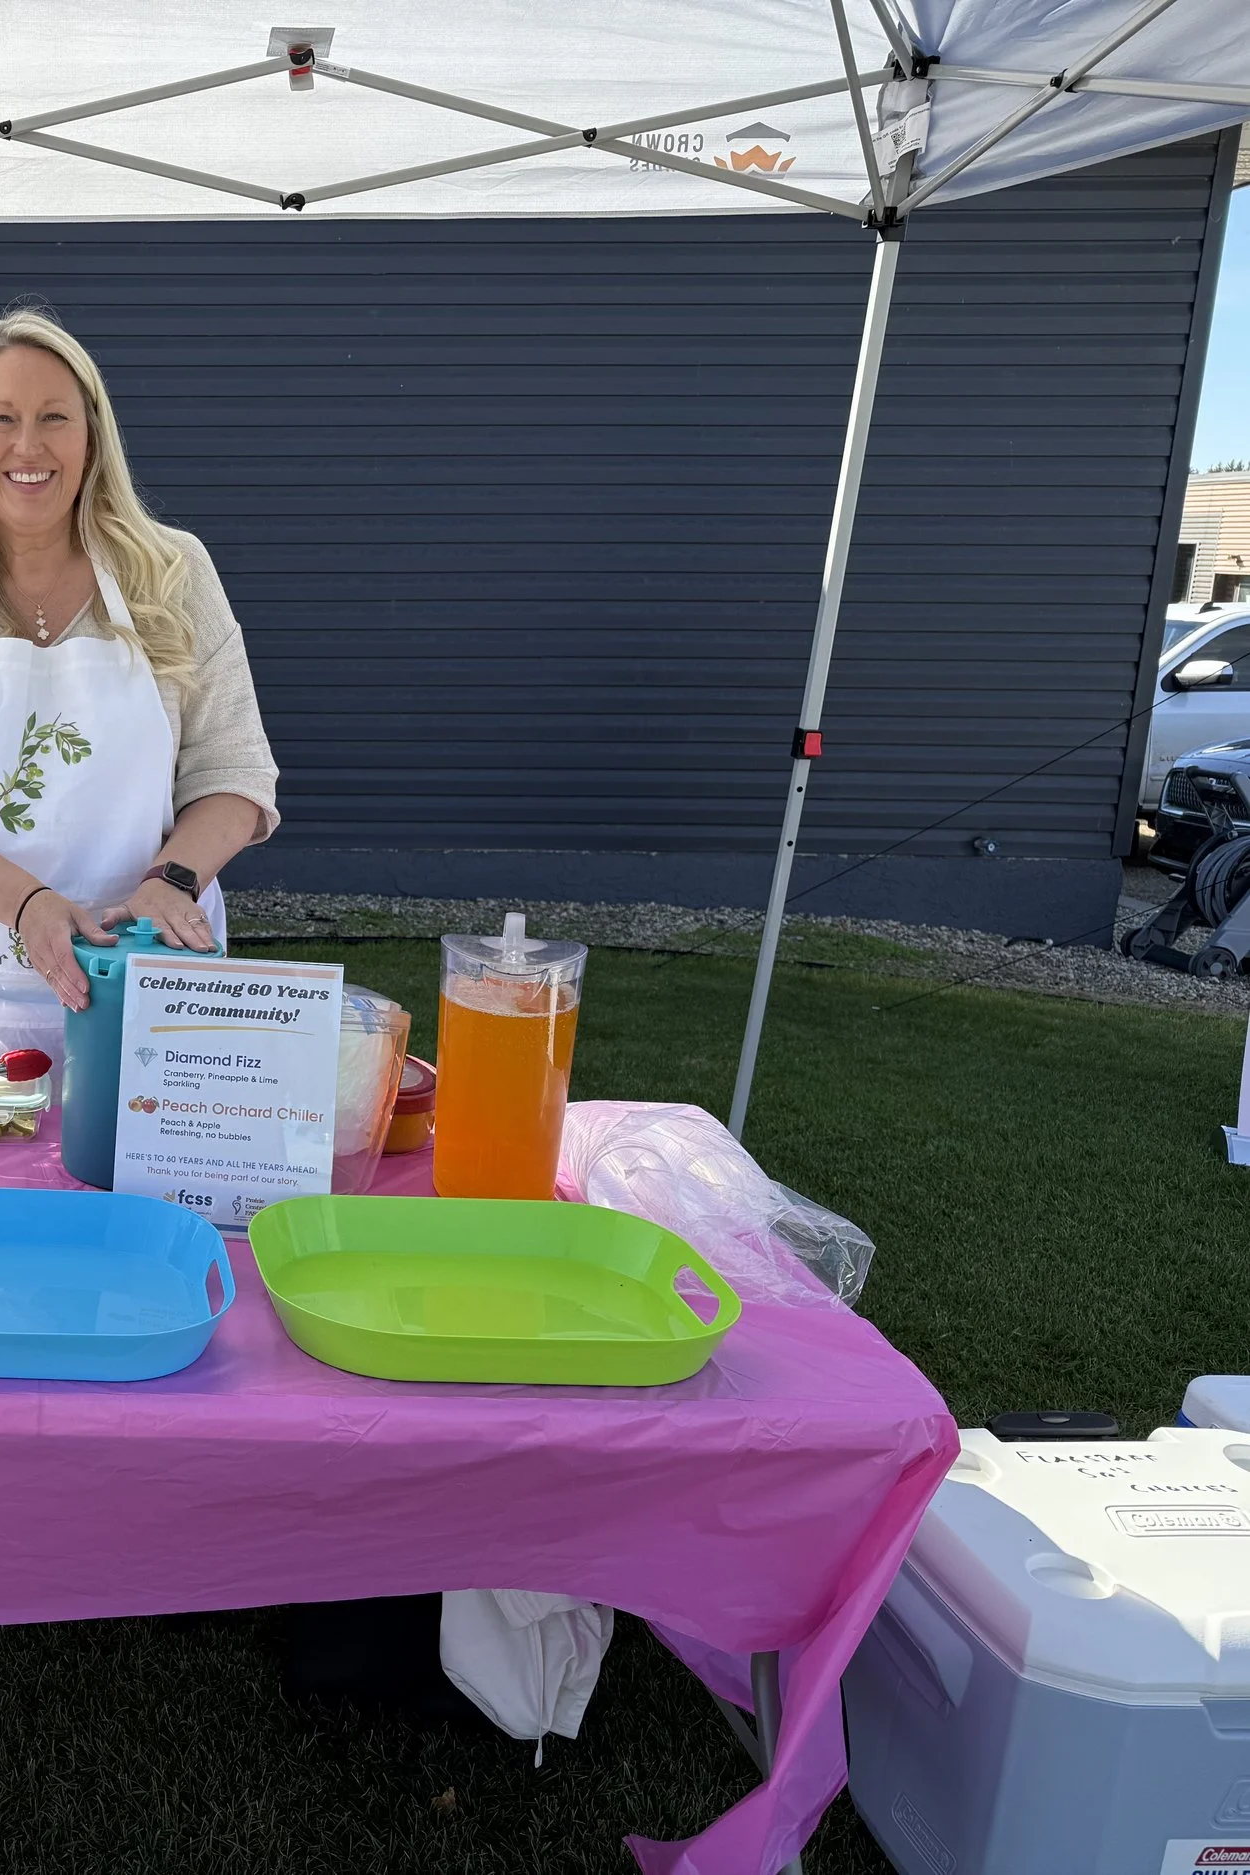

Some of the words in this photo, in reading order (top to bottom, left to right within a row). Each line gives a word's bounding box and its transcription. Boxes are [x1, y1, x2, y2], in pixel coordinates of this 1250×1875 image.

[139, 976, 245, 997] Celebrating
[247, 984, 272, 996] 60
[277, 985, 330, 1000] Years
[165, 1001, 187, 1016] of
[187, 1003, 300, 1024] Community!
[165, 1051, 231, 1067] Diamond
[236, 1055, 262, 1068] Fizz
[163, 1079, 200, 1090] Sparkling
[164, 1069, 206, 1081] Cranberry,
[208, 1073, 249, 1084] Pineapple
[259, 1076, 278, 1084] Lime
[162, 1099, 207, 1114] Peach
[213, 1102, 272, 1120] Orchard
[277, 1108, 324, 1123] Chiller
[161, 1118, 186, 1128] Peach
[196, 1121, 221, 1130] Apple
[160, 1128, 203, 1139] Refreshing,
[218, 1132, 251, 1142] bubbles
[126, 1152, 152, 1161] HERE'S
[154, 1154, 164, 1162] TO
[167, 1155, 176, 1163] 60
[178, 1155, 204, 1165] YEARS
[206, 1158, 224, 1166] AND
[226, 1159, 241, 1168] ALL
[243, 1161, 256, 1169] THE
[258, 1162, 284, 1172] YEARS
[286, 1164, 318, 1174] AHEAD!
[147, 1166, 172, 1176] Thank
[174, 1170, 189, 1179] you
[191, 1169, 202, 1178] for
[204, 1171, 229, 1182] being
[231, 1174, 249, 1183] part
[251, 1174, 260, 1182] of
[277, 1177, 298, 1187] story.
[177, 1189, 213, 1206] fcss
[1016, 1451, 1158, 1463] FLAGSTAFF
[1130, 1484, 1238, 1493] CHOICES
[1131, 1512, 1219, 1528] Coleman
